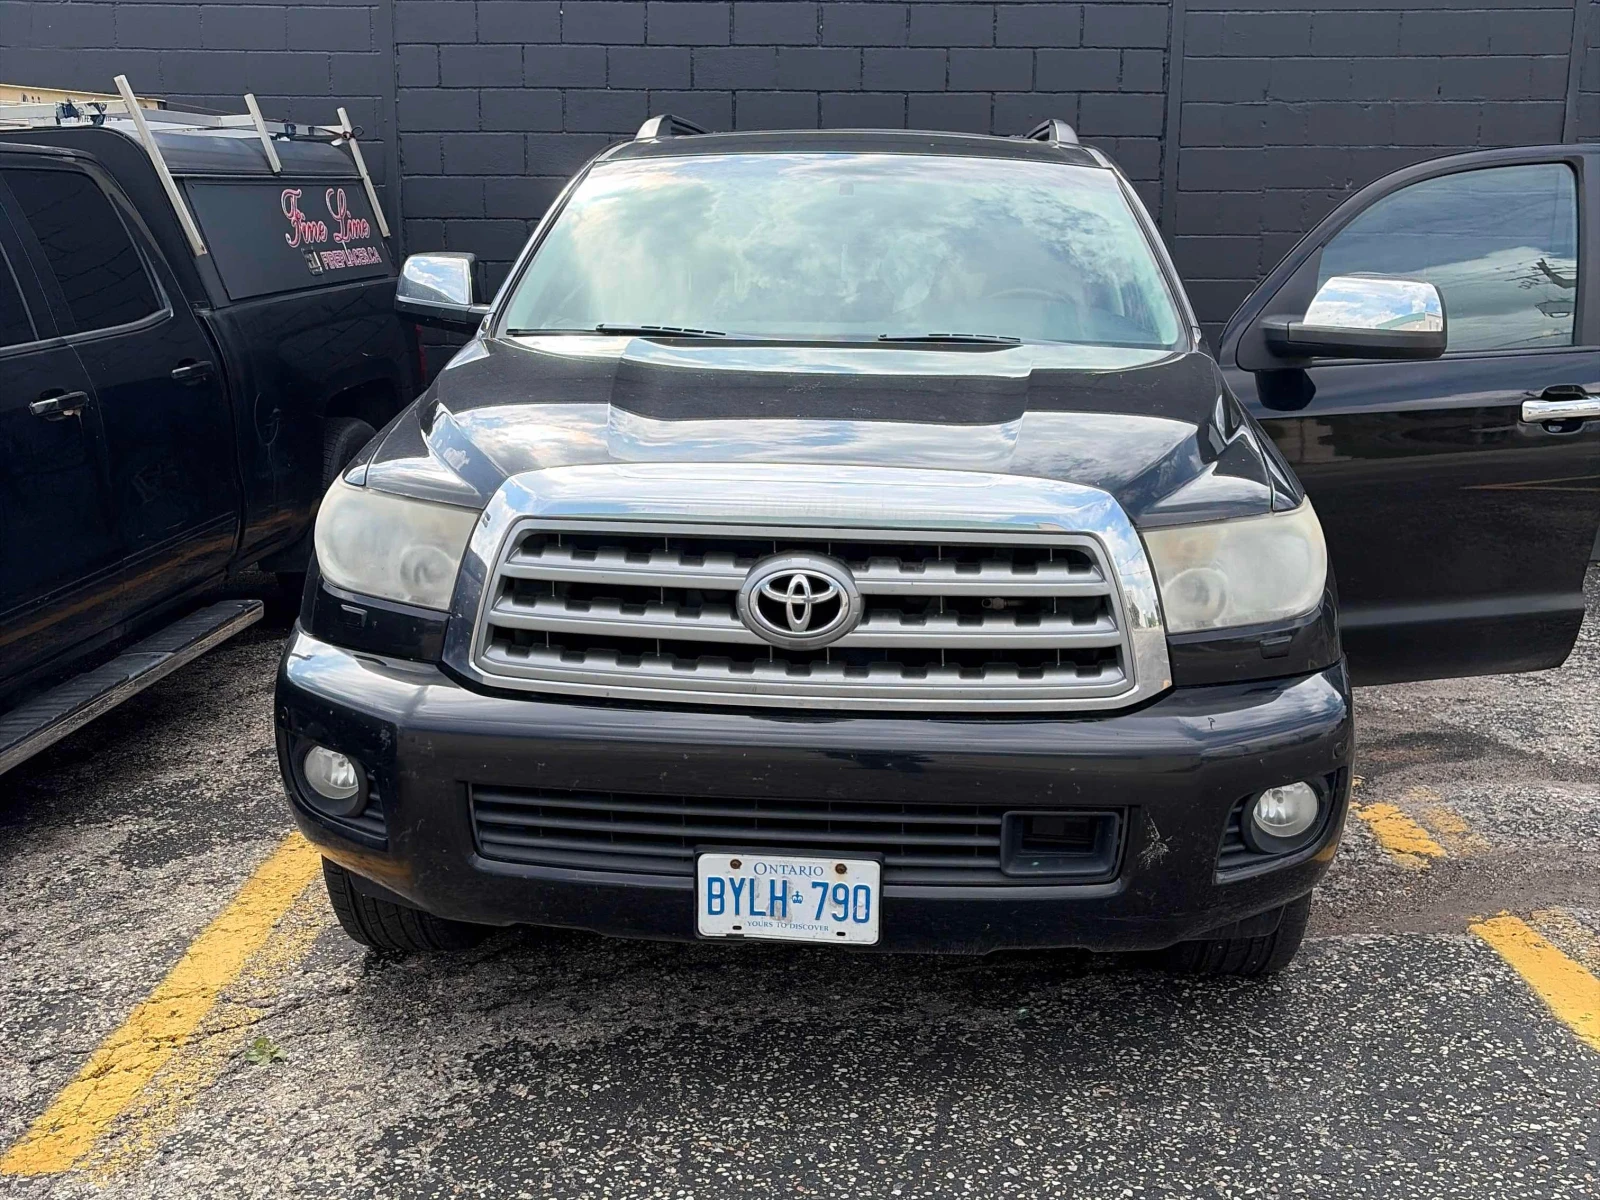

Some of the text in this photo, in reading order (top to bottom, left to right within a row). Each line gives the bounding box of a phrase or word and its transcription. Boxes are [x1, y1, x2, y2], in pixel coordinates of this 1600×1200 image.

[281, 188, 371, 248] Fine Line
[707, 877, 871, 924] BYLH 790
[789, 923, 829, 932] DISCOVER
